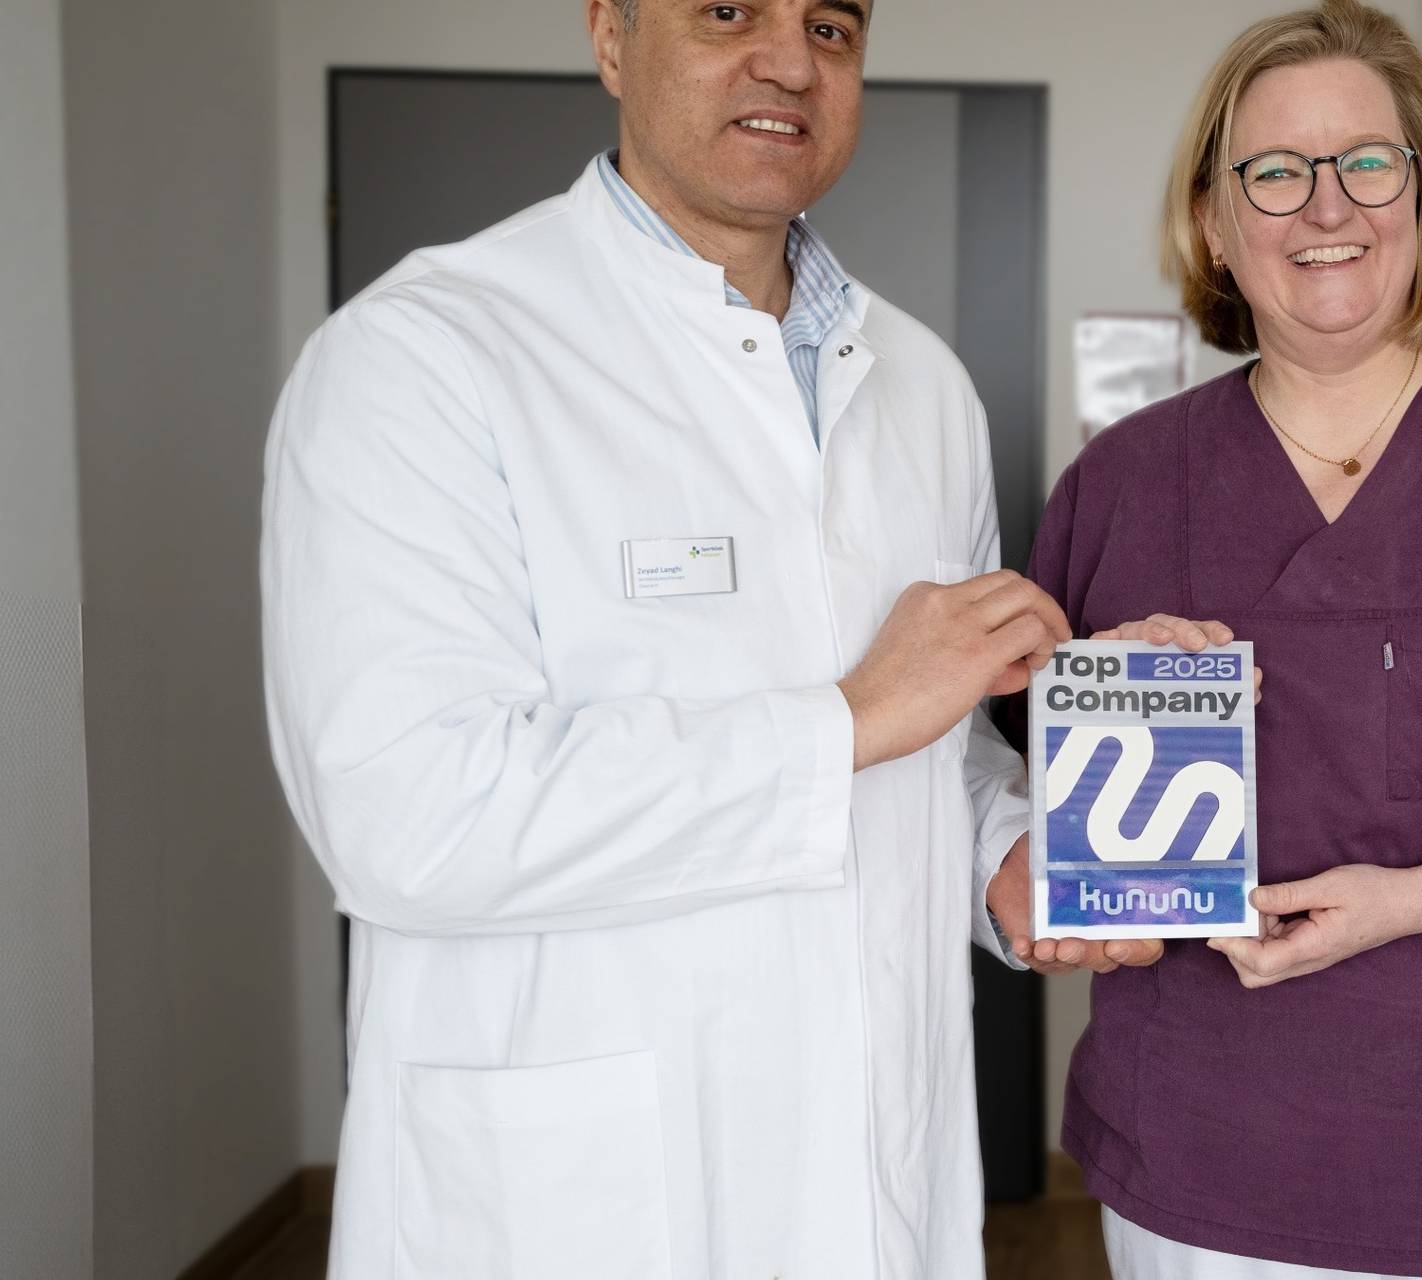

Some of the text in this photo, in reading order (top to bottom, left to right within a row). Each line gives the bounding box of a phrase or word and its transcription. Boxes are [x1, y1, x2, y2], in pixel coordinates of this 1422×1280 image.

[1050, 651, 1236, 683] Top 2025
[1046, 685, 1243, 720] Company
[1079, 881, 1215, 915] kununu
